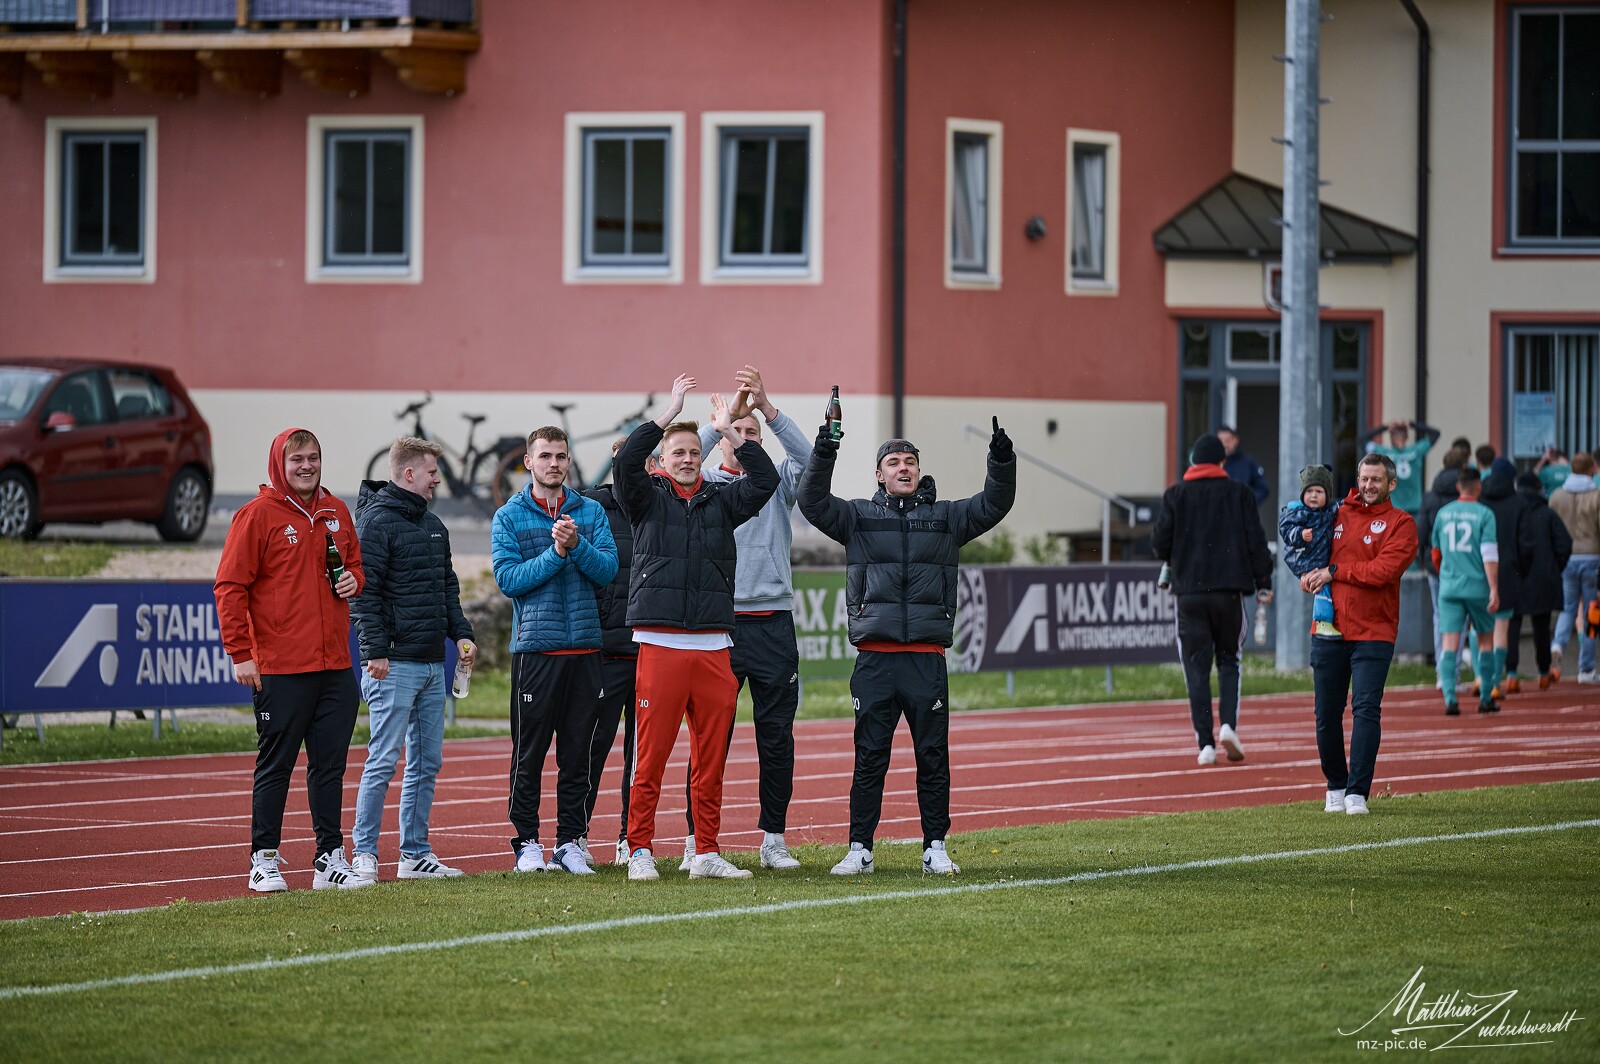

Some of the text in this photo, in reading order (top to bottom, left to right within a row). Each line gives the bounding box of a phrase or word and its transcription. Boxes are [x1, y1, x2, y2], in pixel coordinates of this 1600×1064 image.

[287, 536, 298, 544] TS
[1442, 521, 1473, 553] 12
[1056, 583, 1108, 623] MAX
[136, 603, 220, 642] STAHL
[522, 693, 533, 703] TB
[260, 712, 270, 721] TS
